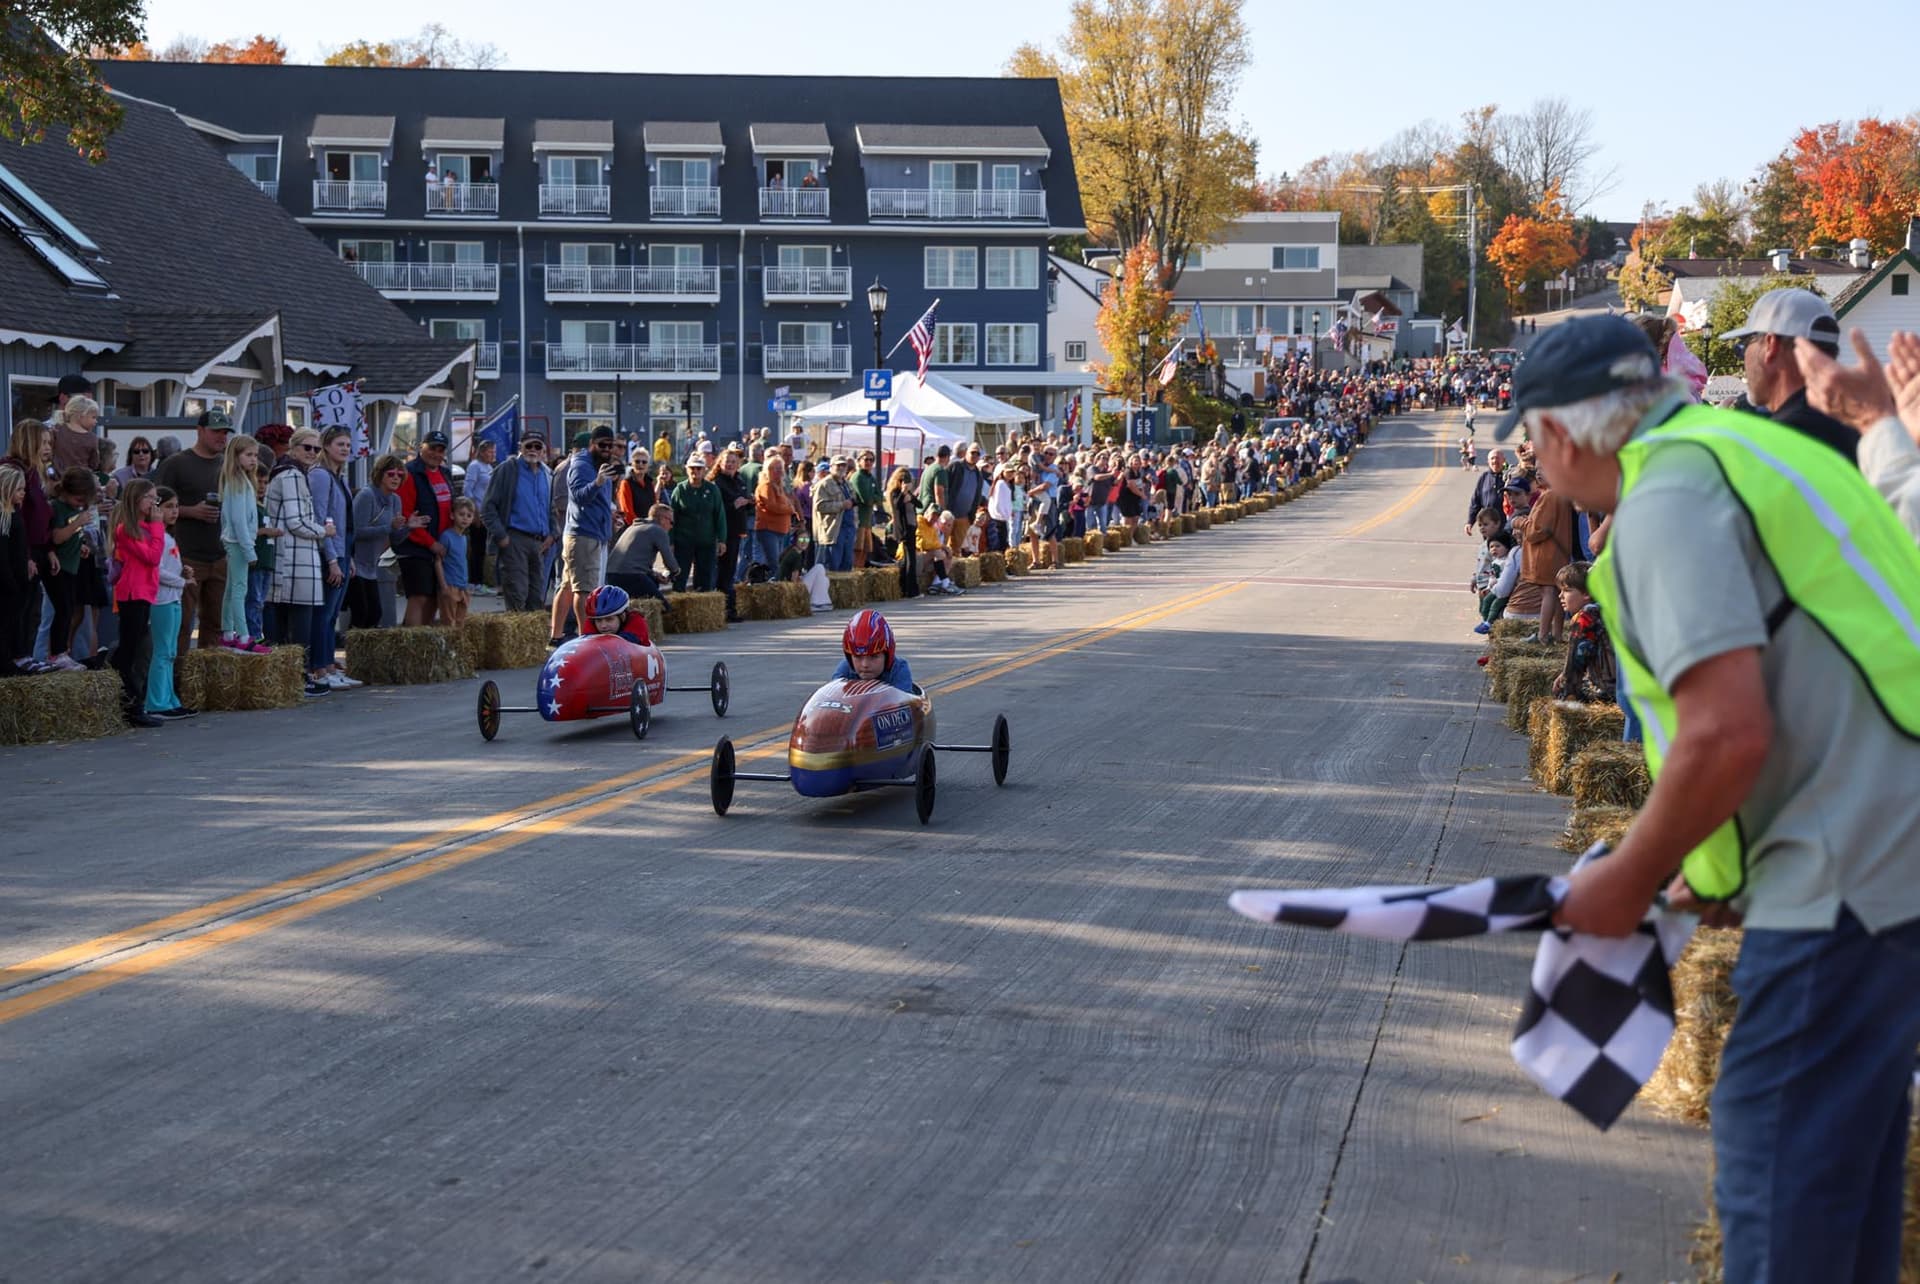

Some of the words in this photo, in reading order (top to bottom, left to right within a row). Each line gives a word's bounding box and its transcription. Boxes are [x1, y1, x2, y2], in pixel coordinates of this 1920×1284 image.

[328, 389, 345, 423] OP
[877, 714, 891, 730] ON
[891, 709, 911, 727] DECK
